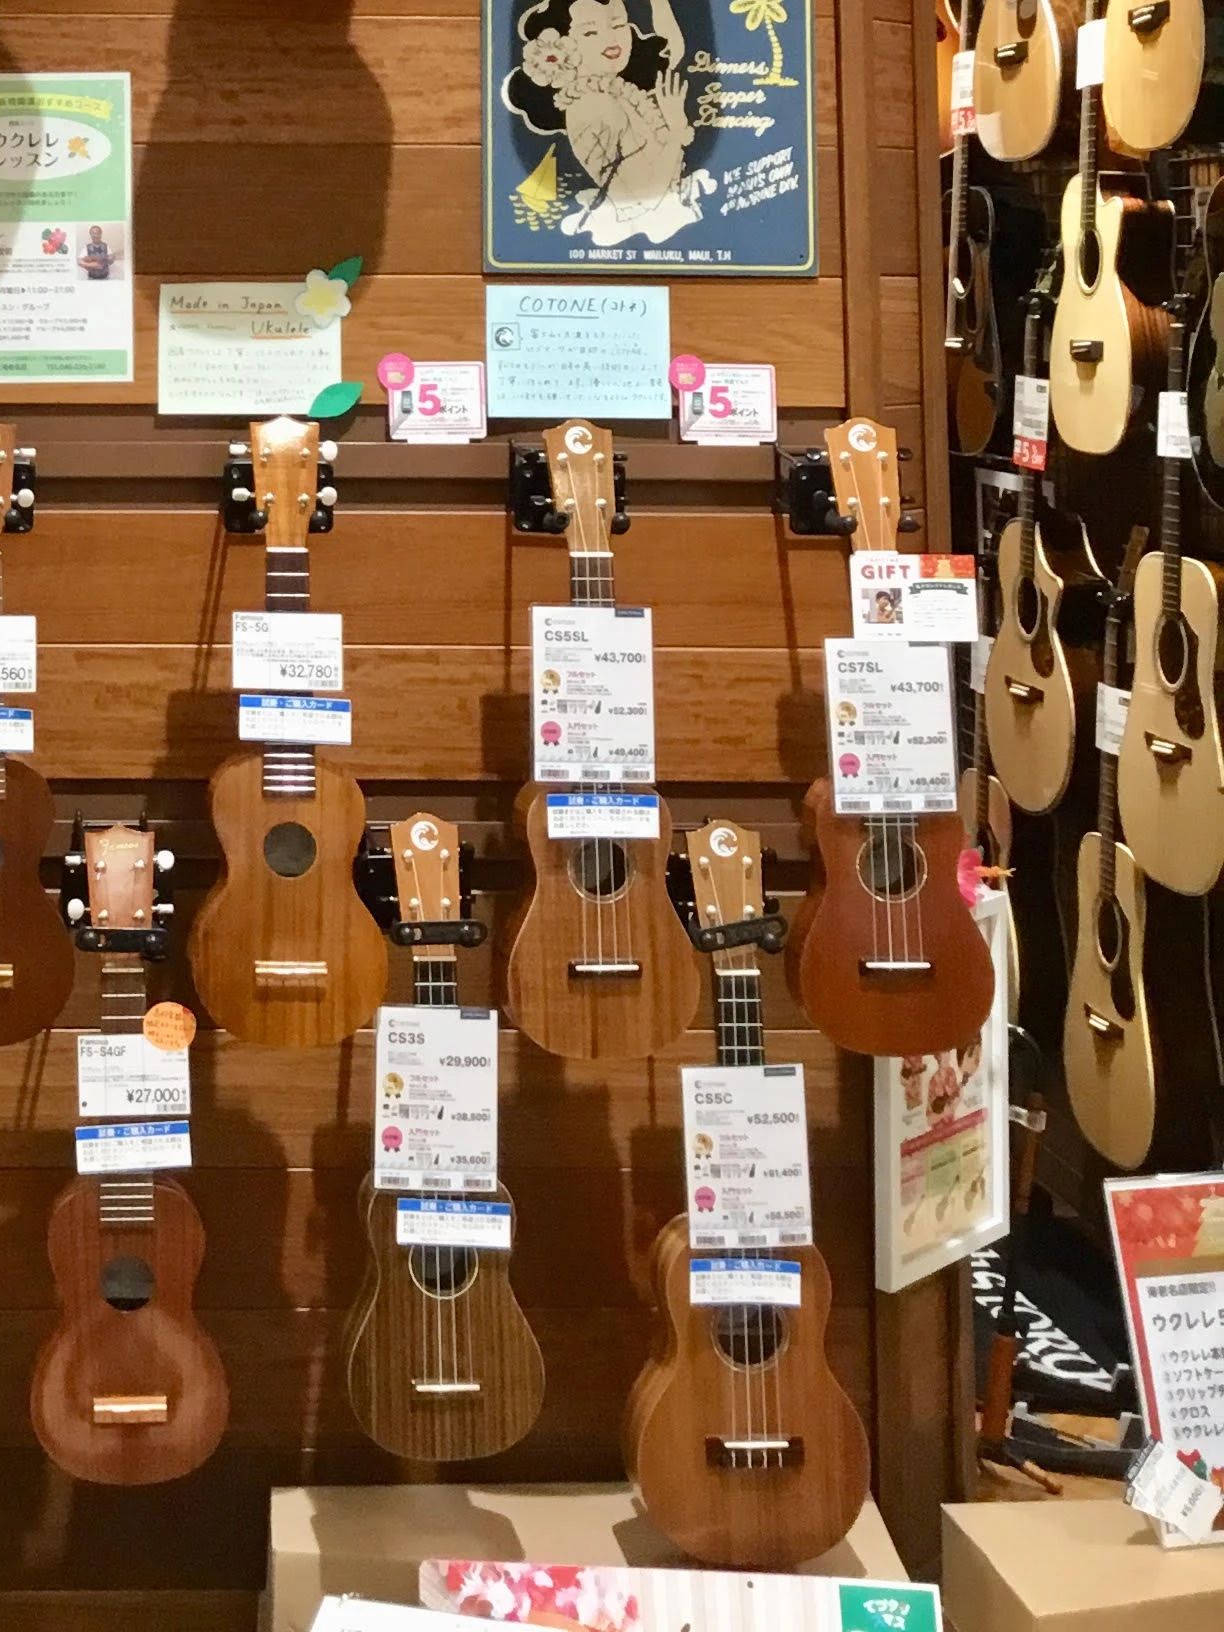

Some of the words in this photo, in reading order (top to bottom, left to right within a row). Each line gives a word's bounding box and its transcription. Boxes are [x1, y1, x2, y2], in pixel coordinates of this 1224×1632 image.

[687, 50, 770, 75] Dinners
[697, 82, 767, 109] Supper
[693, 104, 776, 137] Dancing
[745, 146, 794, 176] SUPPORT
[768, 162, 794, 183] OWN
[569, 250, 585, 260] 100
[588, 249, 623, 260] MARKET
[171, 297, 208, 310] Made
[217, 301, 230, 310] in
[240, 296, 283, 313] Japan
[250, 321, 311, 336] Ukulele
[418, 383, 441, 415] 5
[439, 405, 468, 414] ポイント
[709, 386, 732, 418] 5
[729, 408, 759, 418] ポイント
[861, 565, 910, 580] GIFT
[544, 630, 588, 642] CS5SL
[594, 652, 642, 663] ¥43,700
[280, 664, 332, 678] ¥32,780
[837, 662, 883, 673] CS7SL
[891, 681, 939, 693] ¥43,700
[388, 1032, 425, 1044] CS3S
[439, 1056, 487, 1067] ¥29,900
[127, 1088, 180, 1103] ¥27,000
[695, 1093, 733, 1104] CS5C
[747, 1113, 795, 1124] ¥52,500
